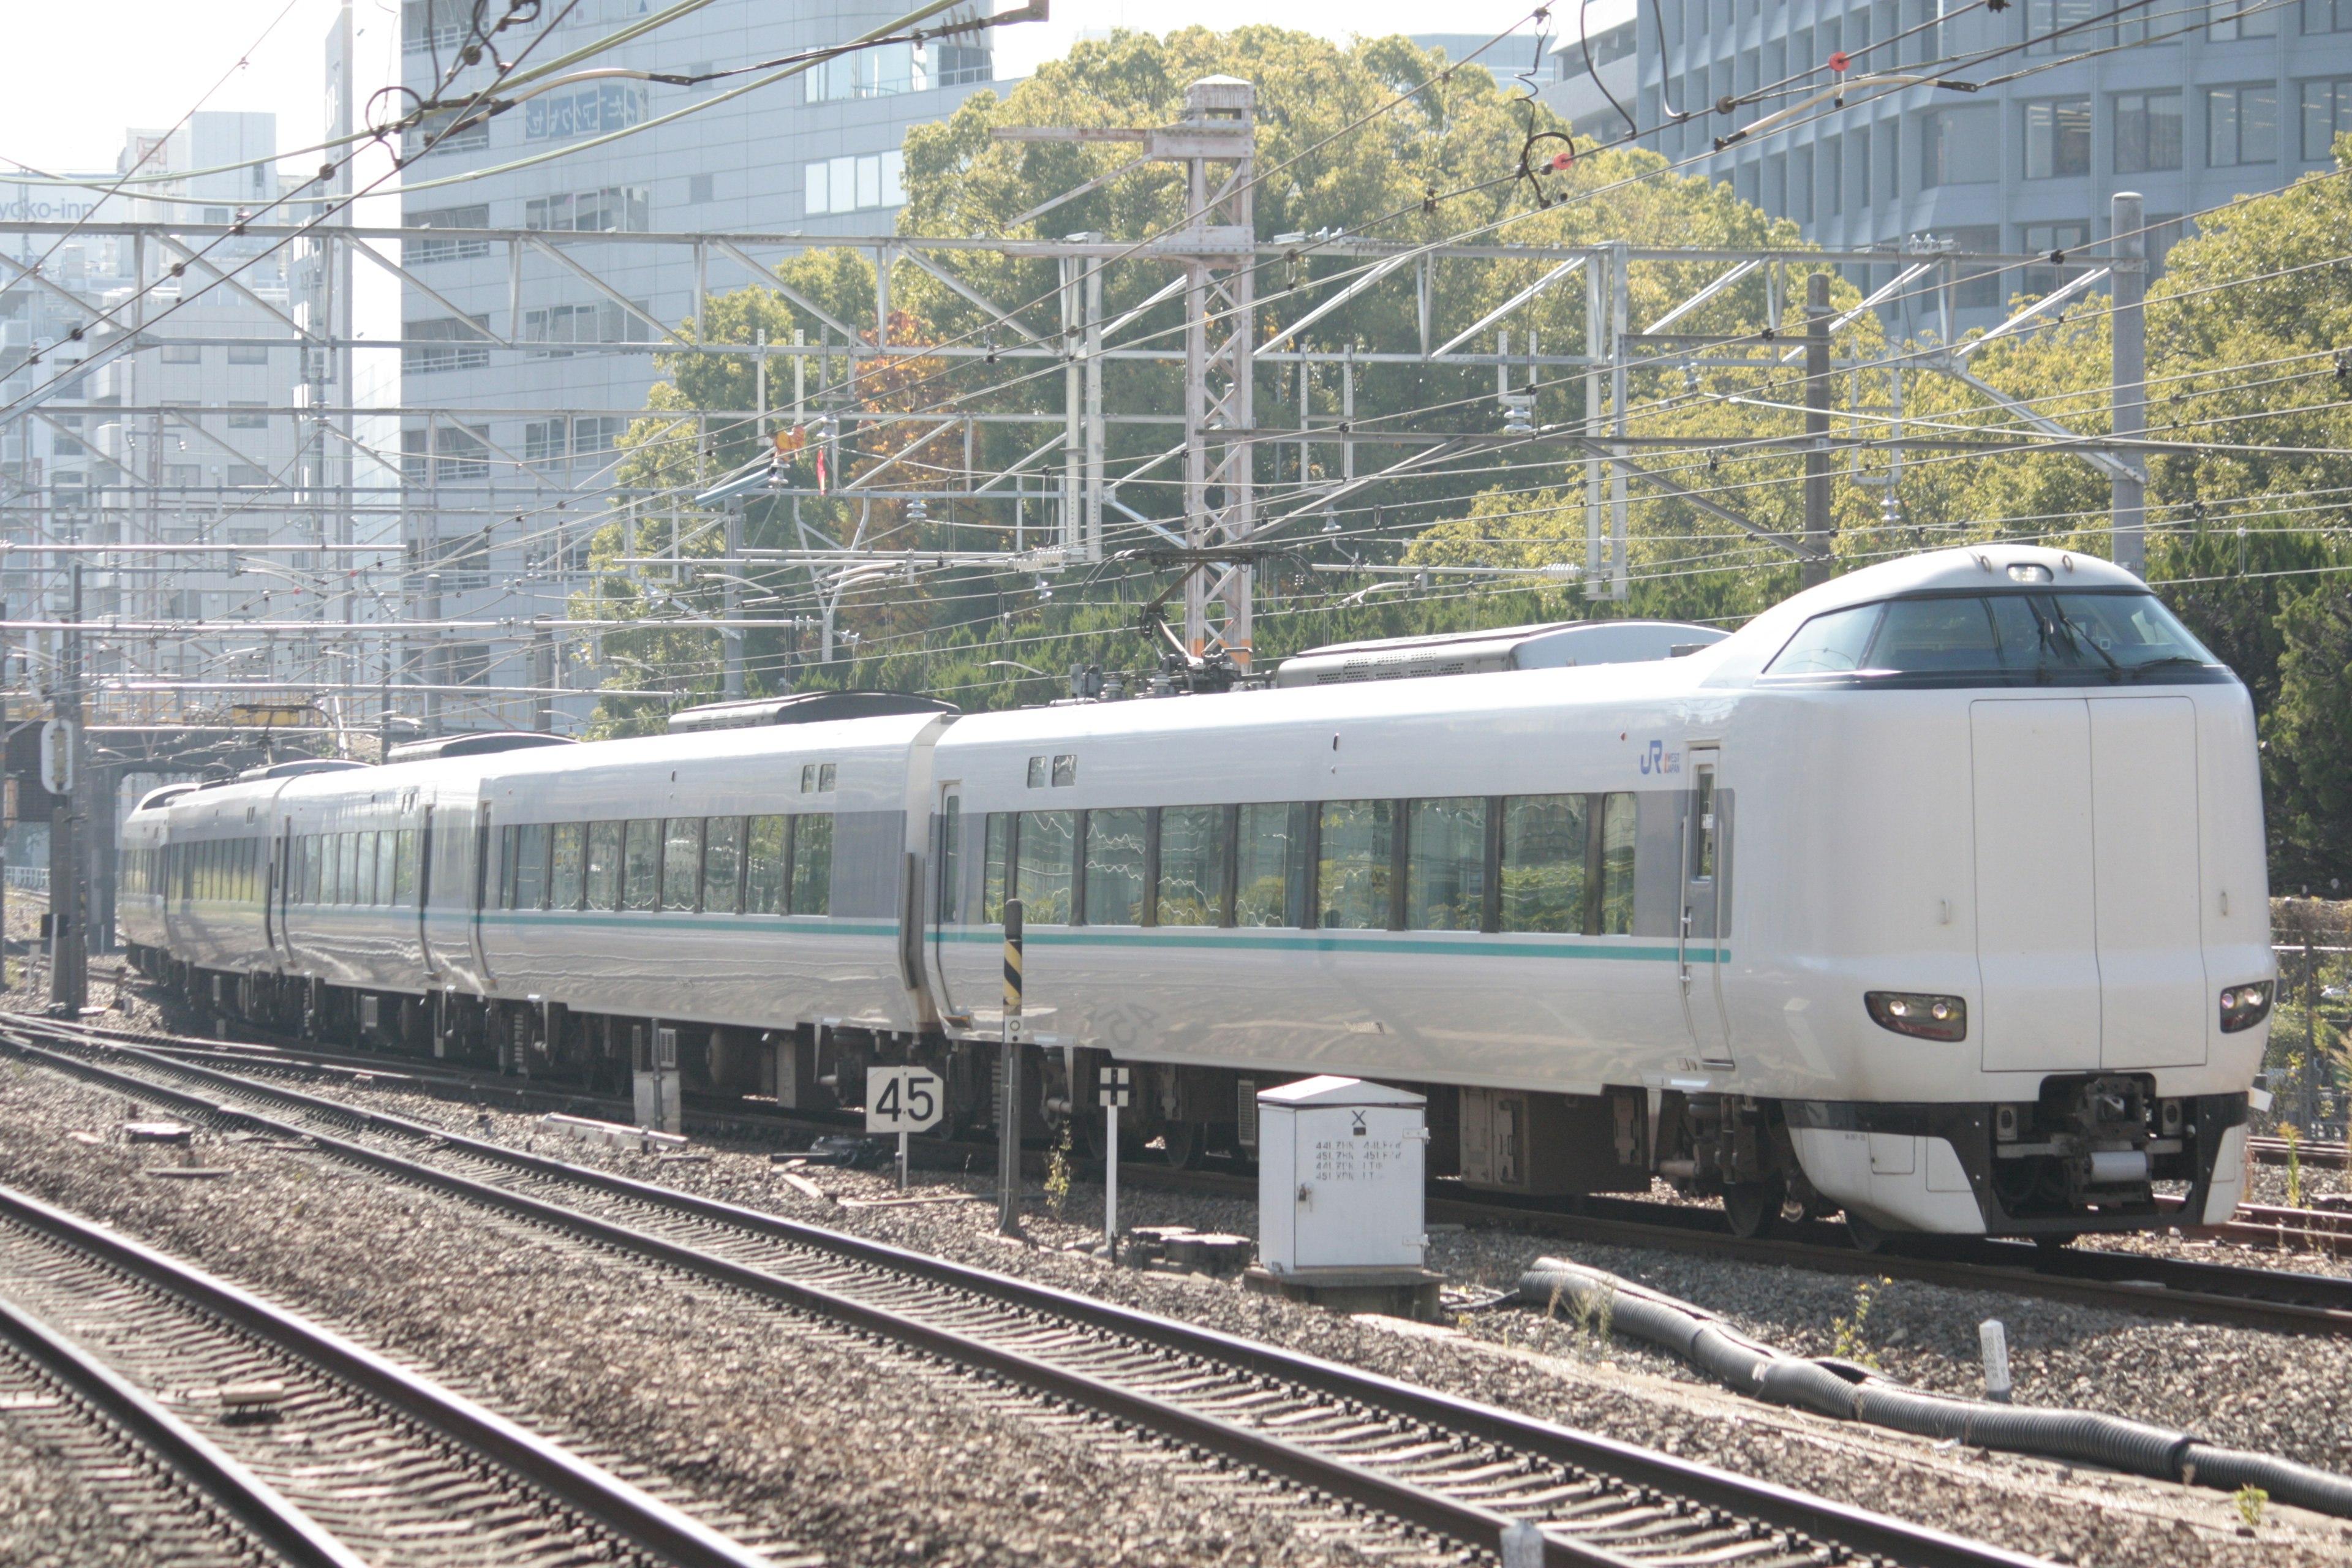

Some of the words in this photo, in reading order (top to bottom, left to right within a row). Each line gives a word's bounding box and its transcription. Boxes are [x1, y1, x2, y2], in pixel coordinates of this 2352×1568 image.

[1640, 739, 1663, 775] JR
[1667, 753, 1680, 763] WEST
[875, 1077, 935, 1122] 45
